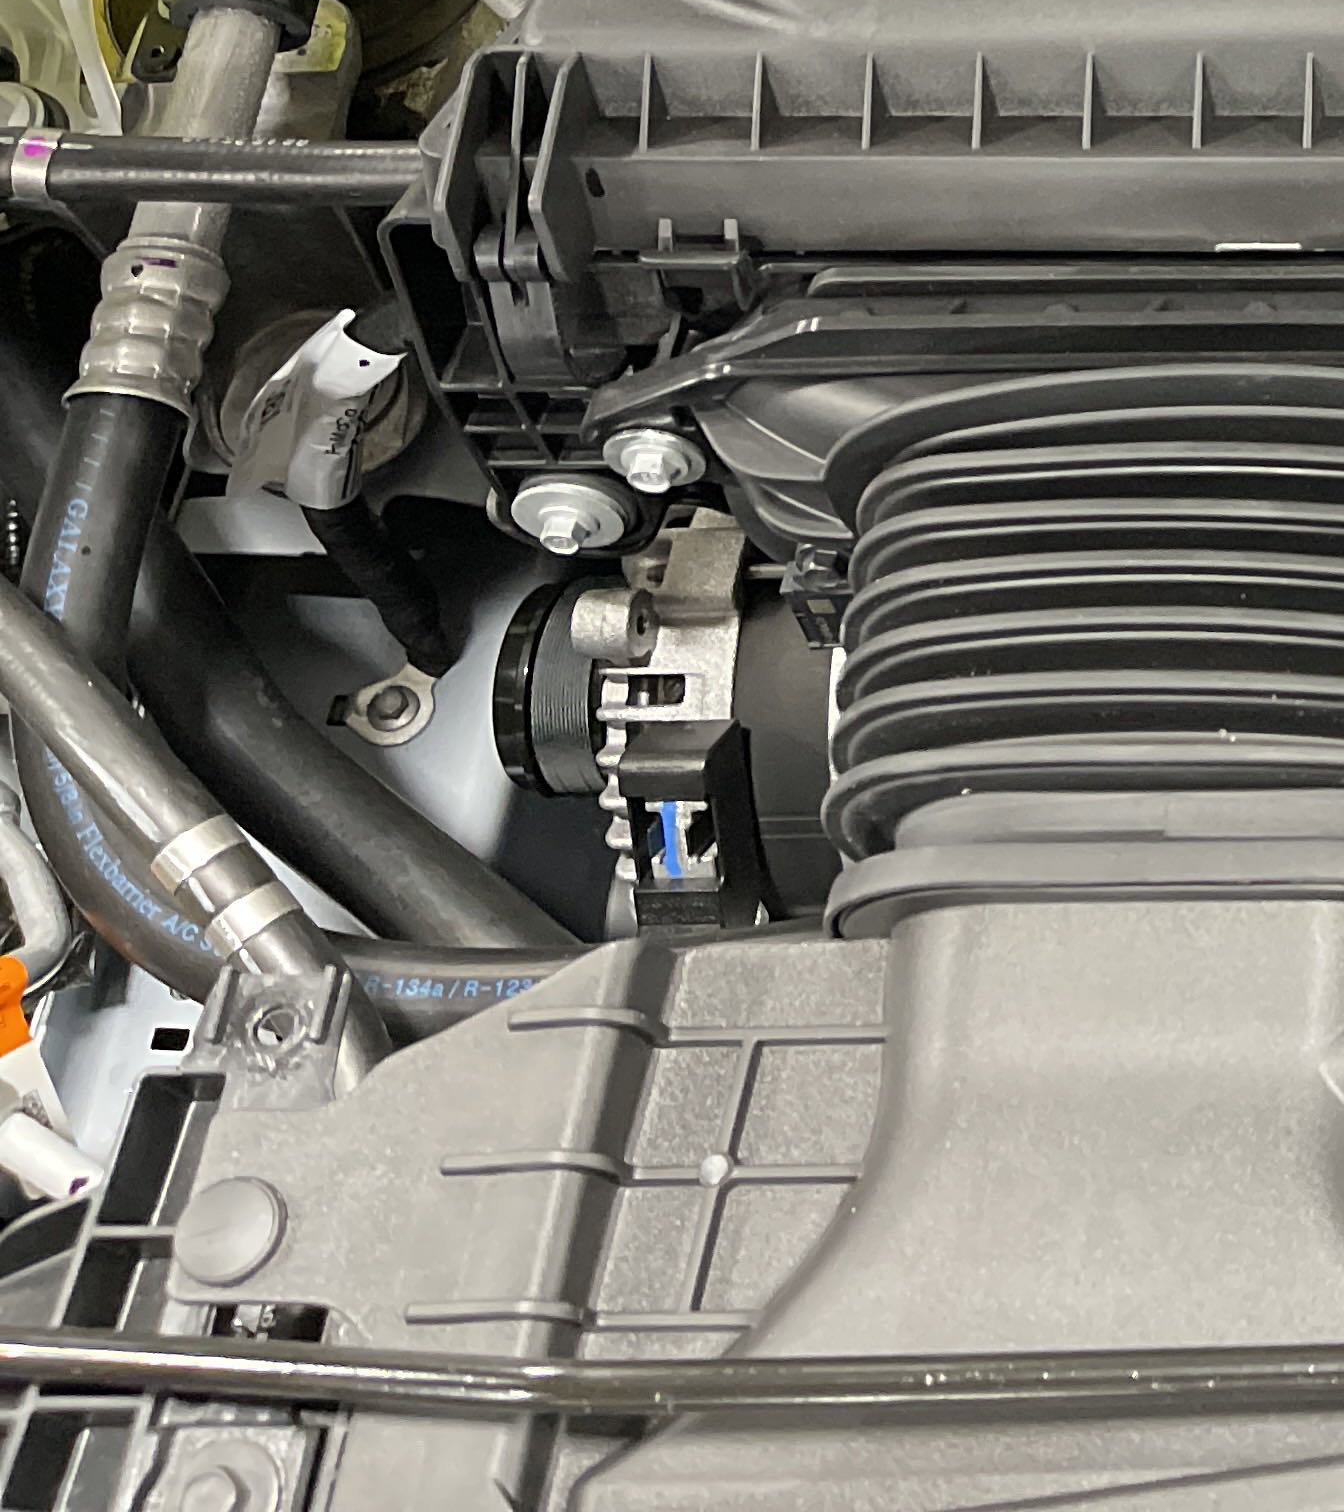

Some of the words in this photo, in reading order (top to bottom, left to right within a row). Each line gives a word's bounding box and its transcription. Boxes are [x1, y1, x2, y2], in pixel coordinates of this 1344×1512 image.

[44, 497, 89, 620] GALAXY
[76, 820, 161, 921] Flexbarrier
[161, 908, 201, 946] A/C
[366, 975, 444, 999] R-134a
